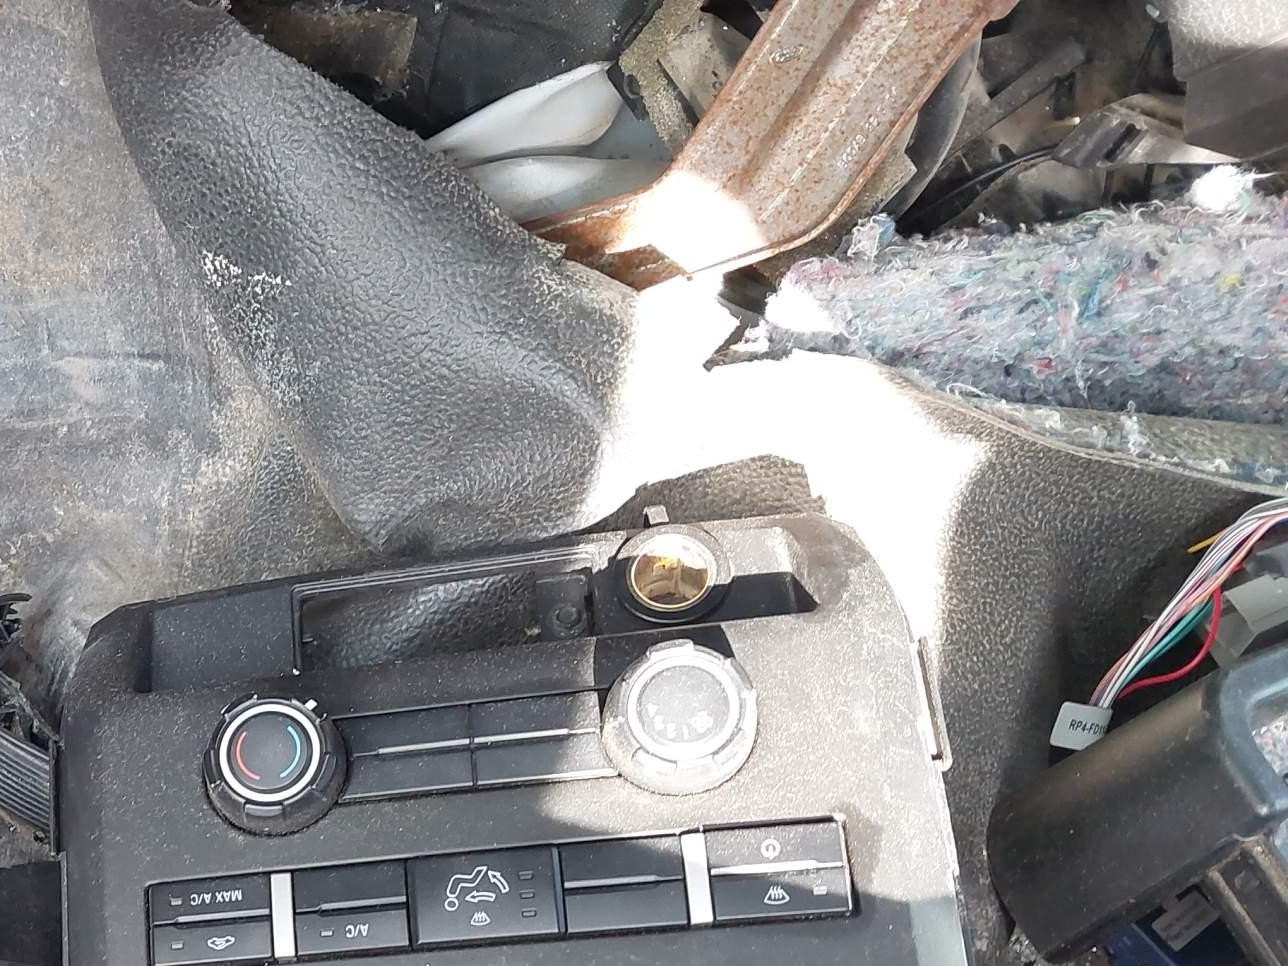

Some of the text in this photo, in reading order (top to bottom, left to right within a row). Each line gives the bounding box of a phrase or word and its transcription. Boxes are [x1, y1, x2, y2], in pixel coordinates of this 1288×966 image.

[190, 888, 243, 906] MAX A/C
[345, 923, 369, 938] A/C
